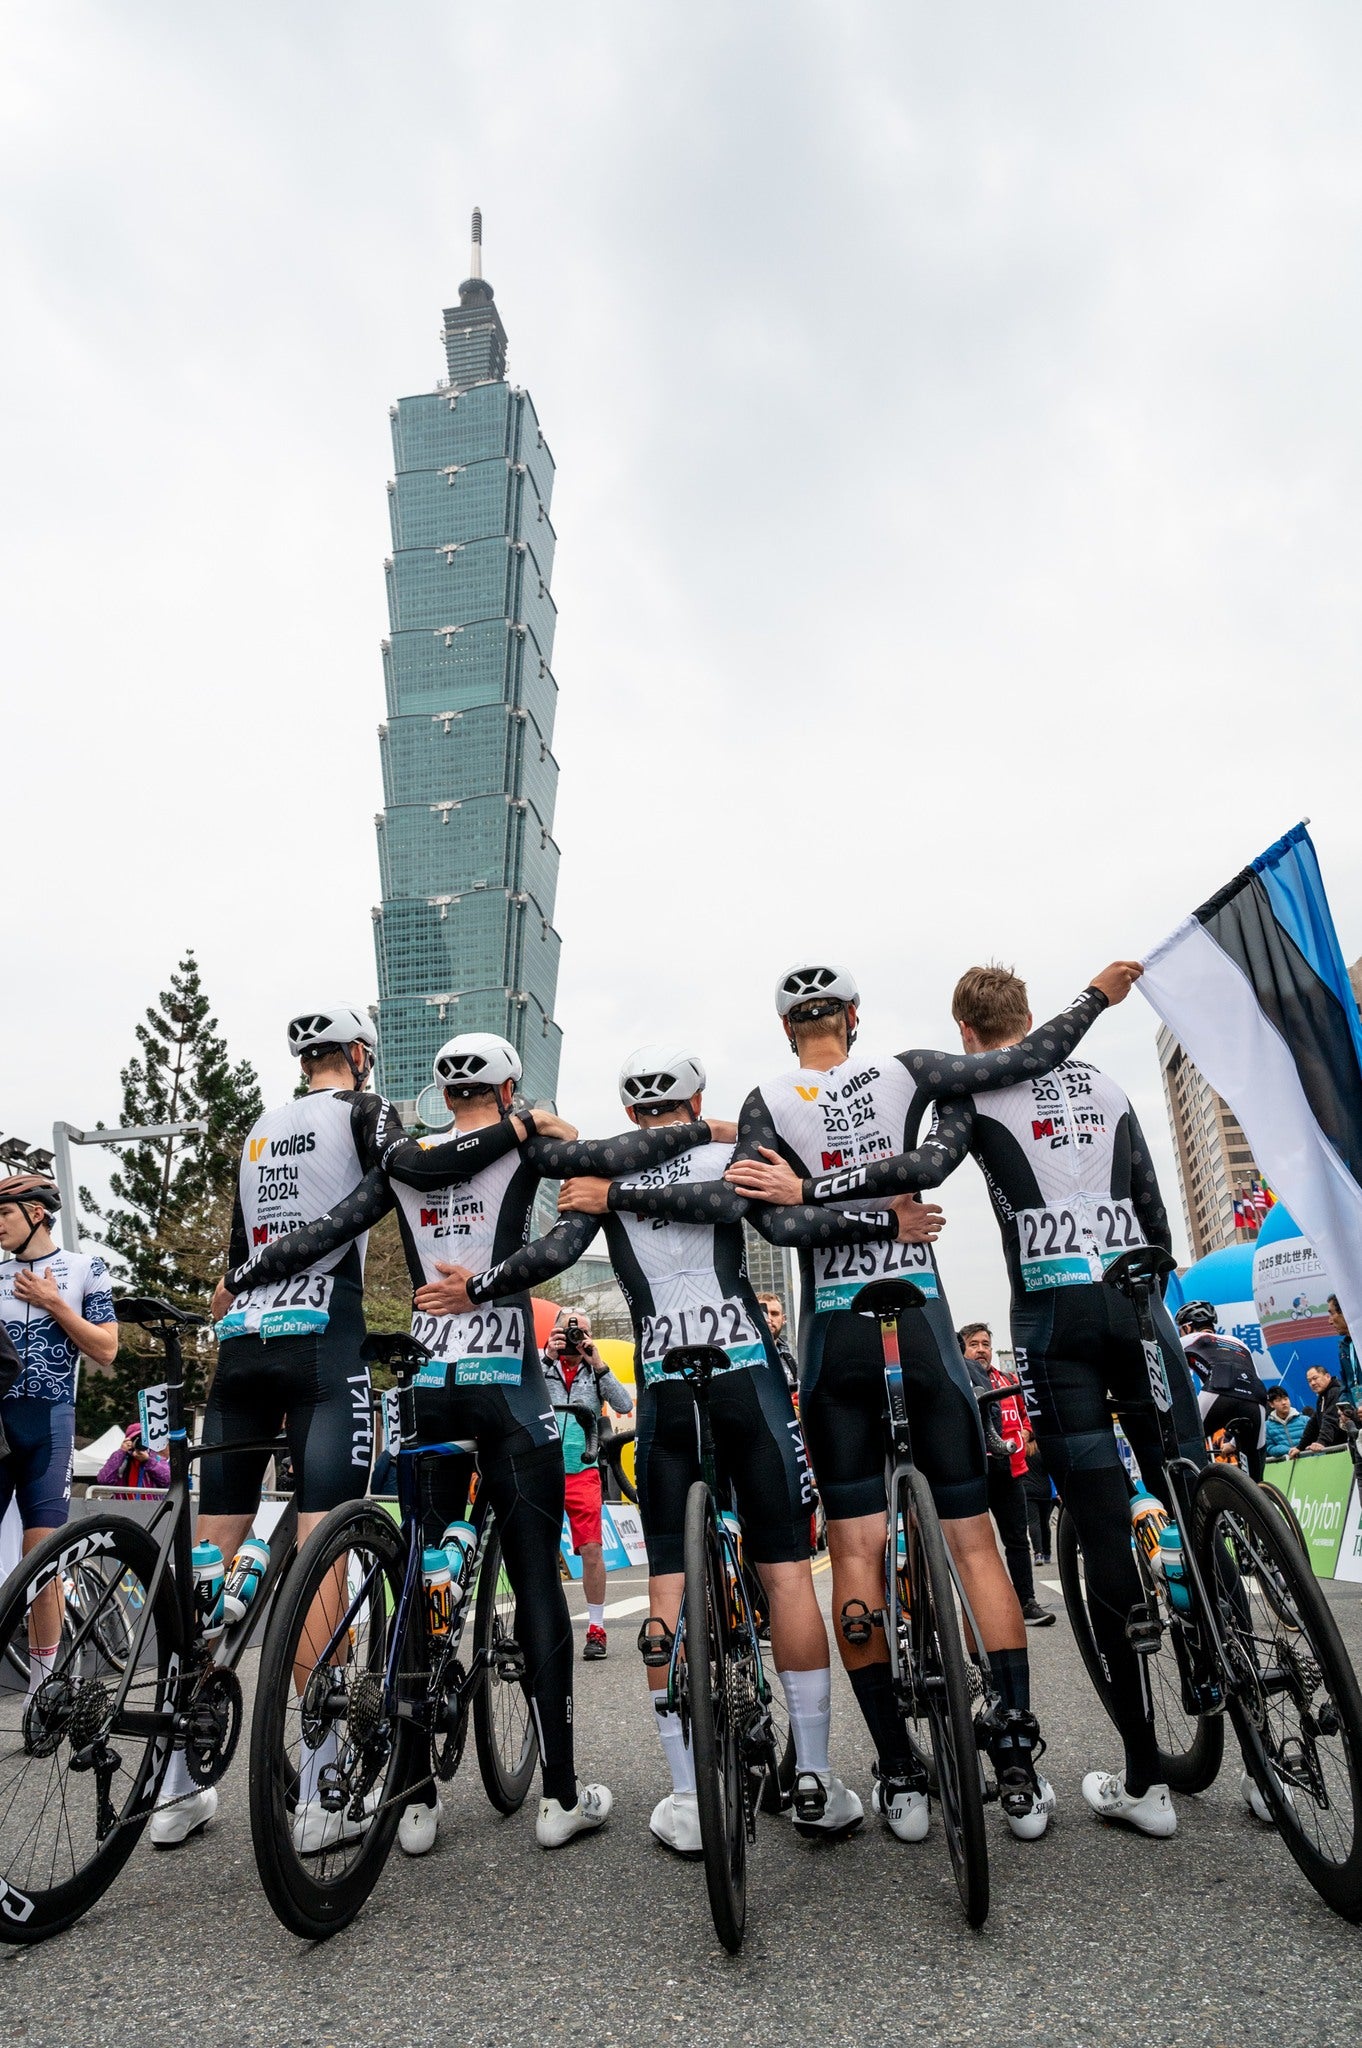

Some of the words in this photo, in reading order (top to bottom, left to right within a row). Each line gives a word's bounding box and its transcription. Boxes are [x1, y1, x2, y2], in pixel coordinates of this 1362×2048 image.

[1032, 1083, 1092, 1101] 2024
[824, 1107, 876, 1132] 2024
[859, 1130, 880, 1142] Culture
[843, 1136, 892, 1159] MAPRI
[640, 1166, 690, 1186] 2024
[258, 1182, 299, 1203] 2024
[257, 1205, 281, 1214] European
[993, 1187, 1016, 1221] 2024
[269, 1220, 312, 1235] MAPR
[1024, 1210, 1081, 1258] 222
[1097, 1206, 1146, 1248] 22
[820, 1243, 876, 1281] 225
[1282, 1260, 1321, 1277] MASTER
[1024, 1275, 1043, 1289] Tour
[1044, 1274, 1056, 1285] De
[1056, 1271, 1090, 1284] Taiwan
[271, 1275, 327, 1308] 223
[817, 1299, 835, 1310] Tour
[837, 1296, 849, 1306] De
[263, 1323, 282, 1334] Tour
[283, 1321, 296, 1332] De
[467, 1312, 521, 1354] 224
[416, 1373, 444, 1386] Taiwan
[458, 1371, 479, 1382] Tour
[480, 1371, 492, 1382] De
[493, 1371, 521, 1383] Taiwan
[1146, 1349, 1167, 1402] 222
[146, 1390, 169, 1440] 223
[1300, 1493, 1342, 1537] bryton
